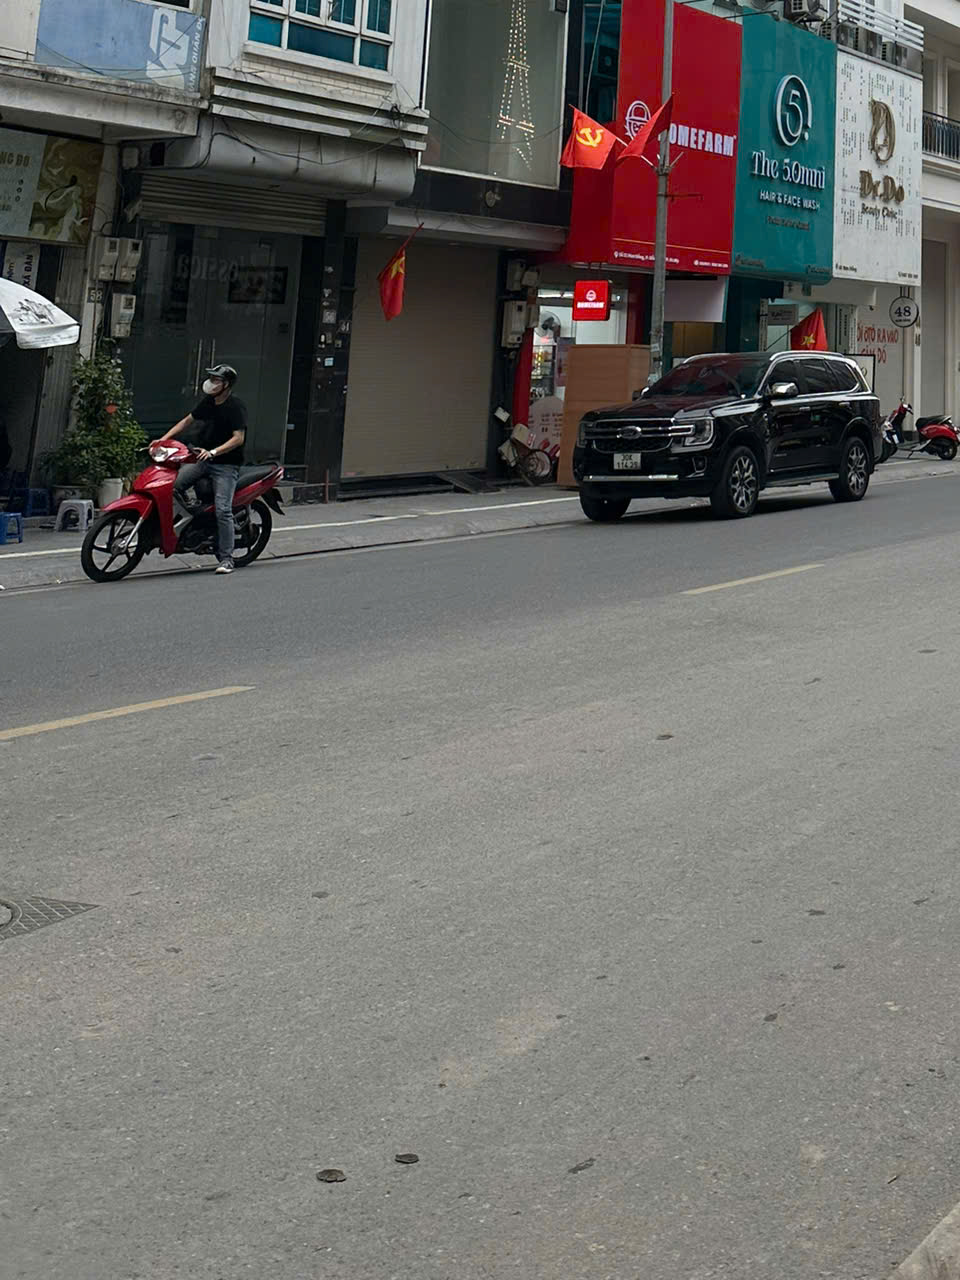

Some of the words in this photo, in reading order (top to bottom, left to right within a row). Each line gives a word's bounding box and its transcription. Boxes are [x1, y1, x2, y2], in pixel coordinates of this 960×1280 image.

[658, 122, 735, 157] OMEFARM
[752, 150, 779, 179] The
[760, 190, 777, 202] HAIR
[784, 193, 801, 207] FACE
[802, 197, 820, 210] WASH
[894, 306, 911, 318] 48
